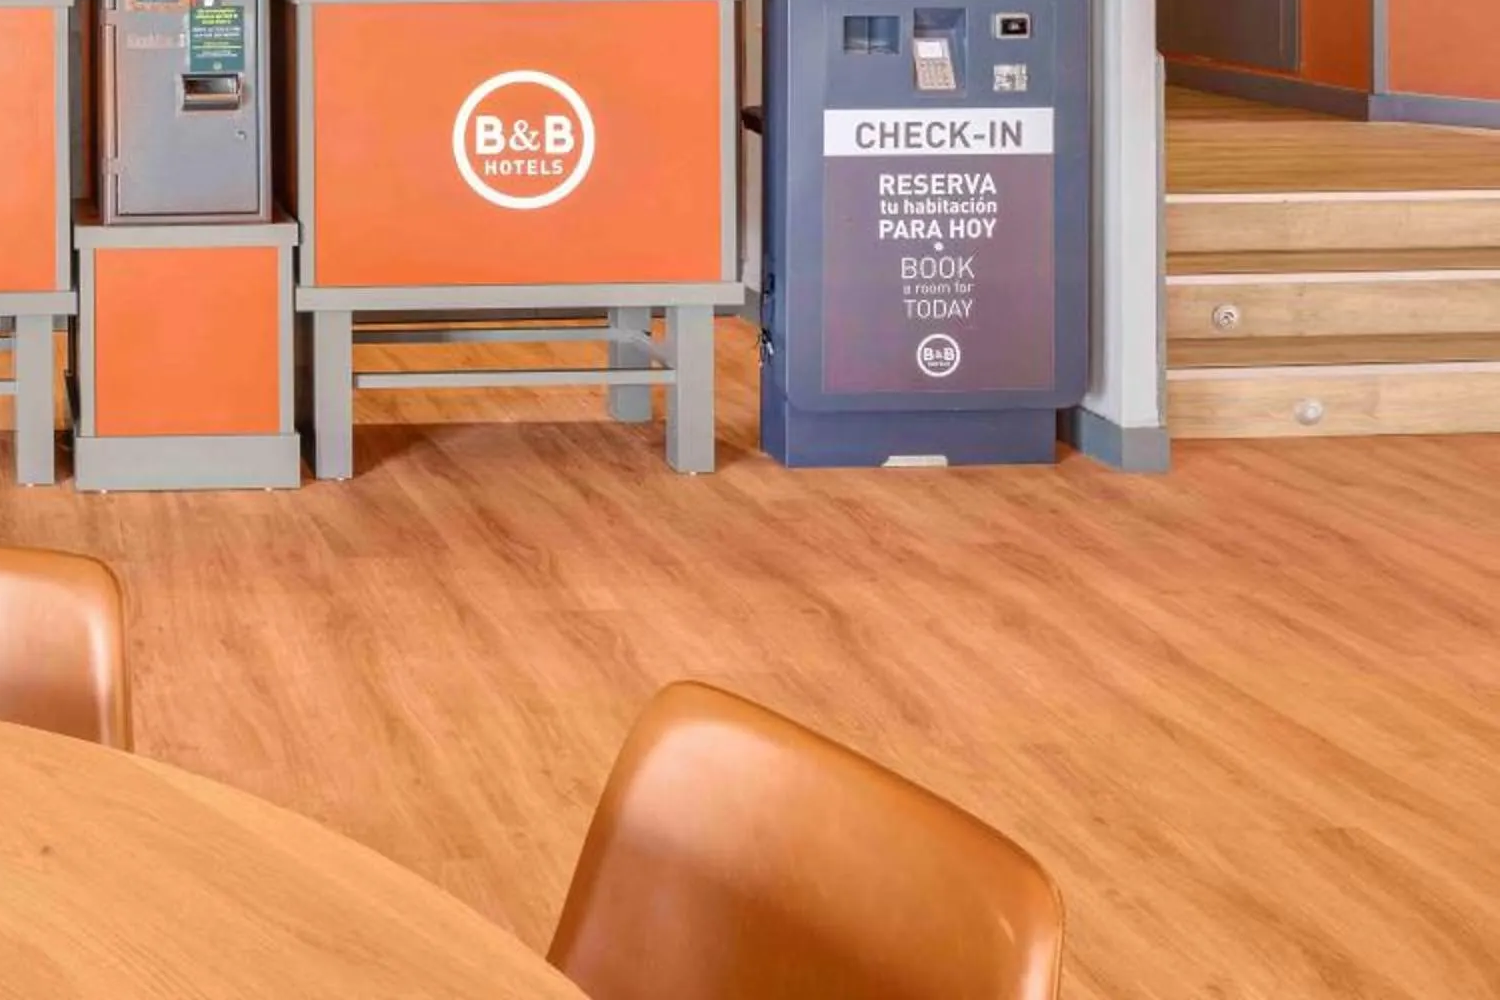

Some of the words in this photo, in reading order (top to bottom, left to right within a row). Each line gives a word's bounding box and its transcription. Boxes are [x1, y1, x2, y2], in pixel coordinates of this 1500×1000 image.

[475, 115, 575, 154] B&B
[855, 119, 1023, 149] CHECK-IN
[484, 159, 565, 176] HOTELS
[878, 172, 998, 196] RESERVA
[879, 199, 899, 215] tu
[903, 196, 998, 215] habitación
[878, 219, 943, 240] PARA
[949, 217, 998, 239] HOY
[900, 256, 976, 279] BOOK
[915, 283, 951, 295] room
[954, 280, 975, 293] for
[902, 298, 973, 319] TODAY
